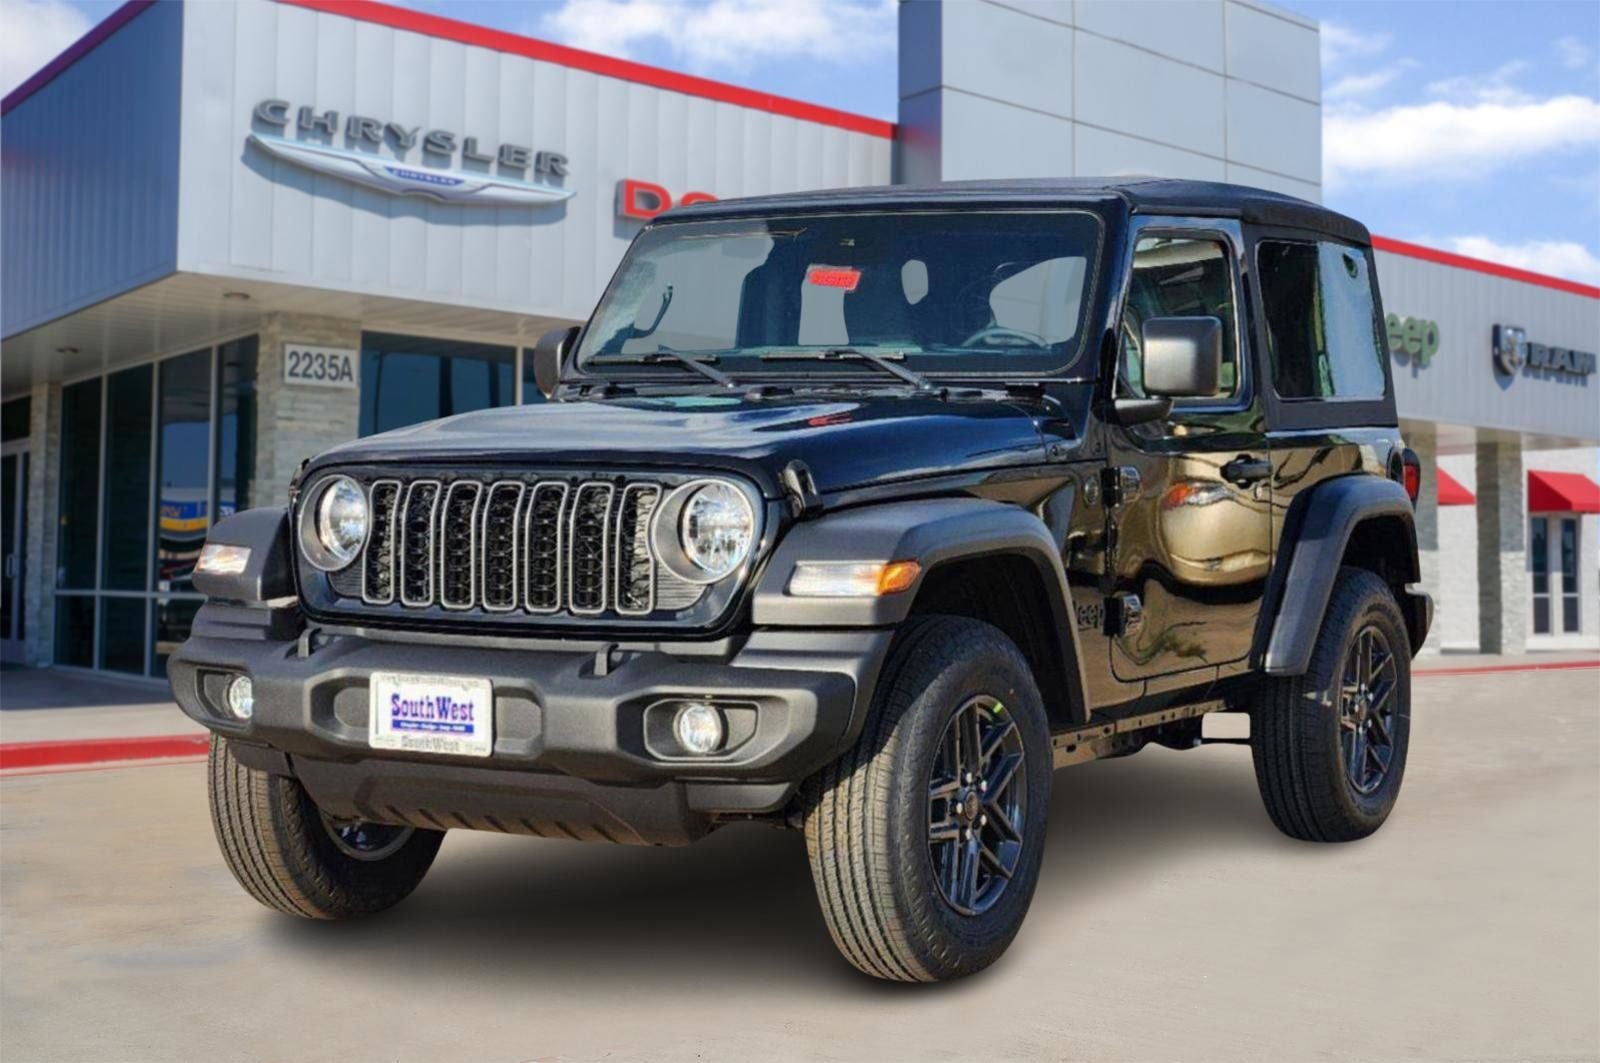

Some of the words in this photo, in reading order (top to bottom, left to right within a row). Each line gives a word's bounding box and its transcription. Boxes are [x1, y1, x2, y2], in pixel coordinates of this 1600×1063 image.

[251, 99, 570, 177] CHRYSLER
[288, 350, 353, 382] 2235A
[1526, 342, 1596, 375] RAM
